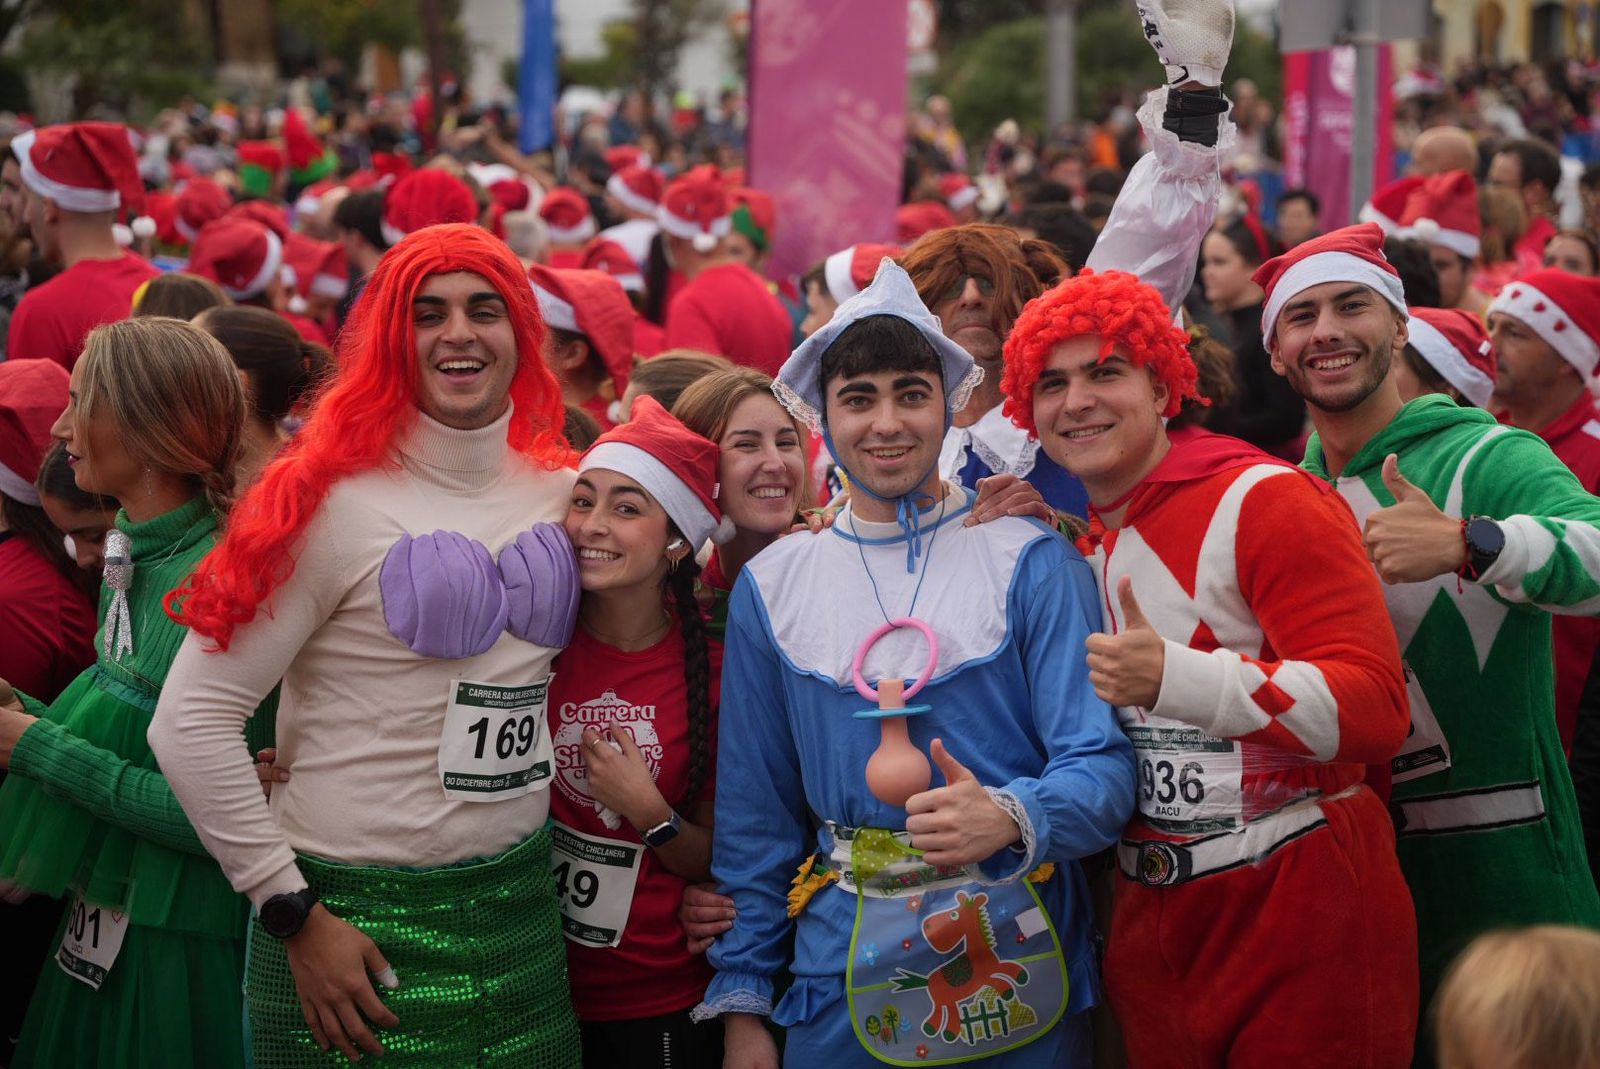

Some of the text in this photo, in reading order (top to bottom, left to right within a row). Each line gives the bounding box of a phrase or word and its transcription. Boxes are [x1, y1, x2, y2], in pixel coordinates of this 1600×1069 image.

[468, 688, 501, 699] CARRERA
[502, 691, 515, 700] SAN
[560, 702, 656, 723] Carrera
[468, 709, 543, 759] 169
[445, 776, 456, 786] 30
[456, 778, 492, 788] DICIEMBRE
[1142, 758, 1205, 804] 936
[585, 844, 627, 858] CHICLANERA
